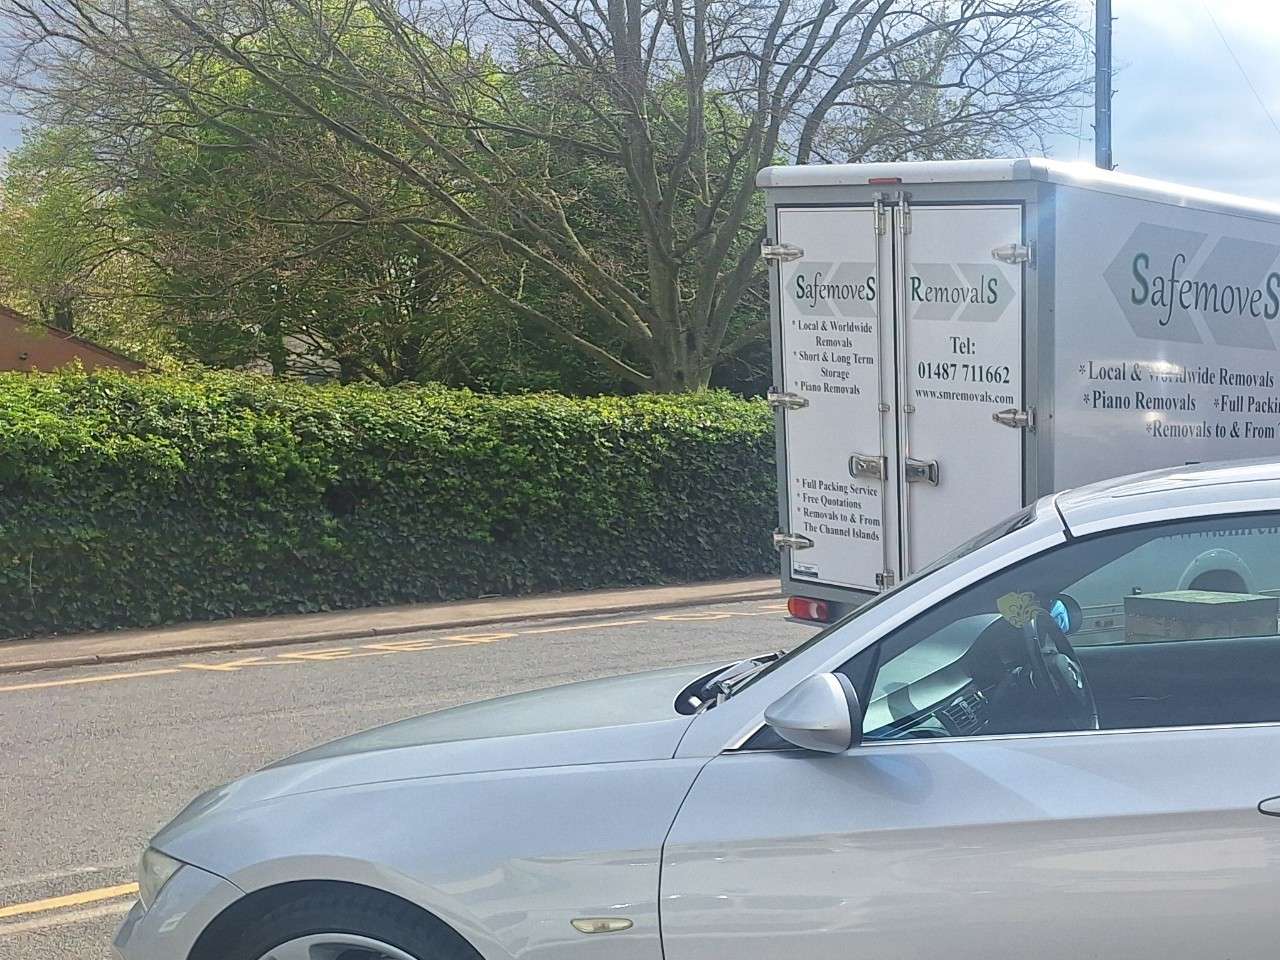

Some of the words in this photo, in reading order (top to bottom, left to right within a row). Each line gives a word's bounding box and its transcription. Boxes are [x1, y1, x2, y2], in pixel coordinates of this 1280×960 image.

[796, 272, 876, 308] SafemoveS
[909, 275, 998, 304] RemovalS
[1131, 253, 1280, 326] SafemoveS
[798, 320, 819, 331] Local
[821, 321, 828, 331] &
[830, 320, 873, 333] Worldwide
[816, 336, 853, 348] Removals
[950, 336, 976, 355] Tel:
[799, 351, 820, 362] Short
[821, 352, 829, 362] &
[831, 352, 851, 366] Long
[853, 353, 874, 365] Term
[821, 367, 850, 380] Storage
[918, 361, 957, 381] 01487
[962, 364, 1010, 384] 711662
[1130, 362, 1142, 382] &
[1219, 367, 1274, 388] Removals
[801, 381, 821, 392] Piano
[823, 382, 860, 395] Removals
[915, 388, 1014, 405] www.smremovals.com
[1135, 391, 1196, 411] Removals
[1215, 422, 1226, 438] to
[1229, 421, 1240, 438] &
[1245, 421, 1274, 439] From
[802, 478, 816, 489] Full
[818, 480, 848, 495] Packing
[850, 484, 878, 497] Service
[802, 493, 819, 504] Free
[820, 495, 862, 510] Quotations
[803, 507, 838, 521] Removals
[840, 513, 848, 522] to
[850, 514, 856, 524] &
[859, 515, 880, 527] From
[804, 521, 817, 533] The
[819, 523, 850, 537] Channel
[852, 528, 879, 541] Islands
